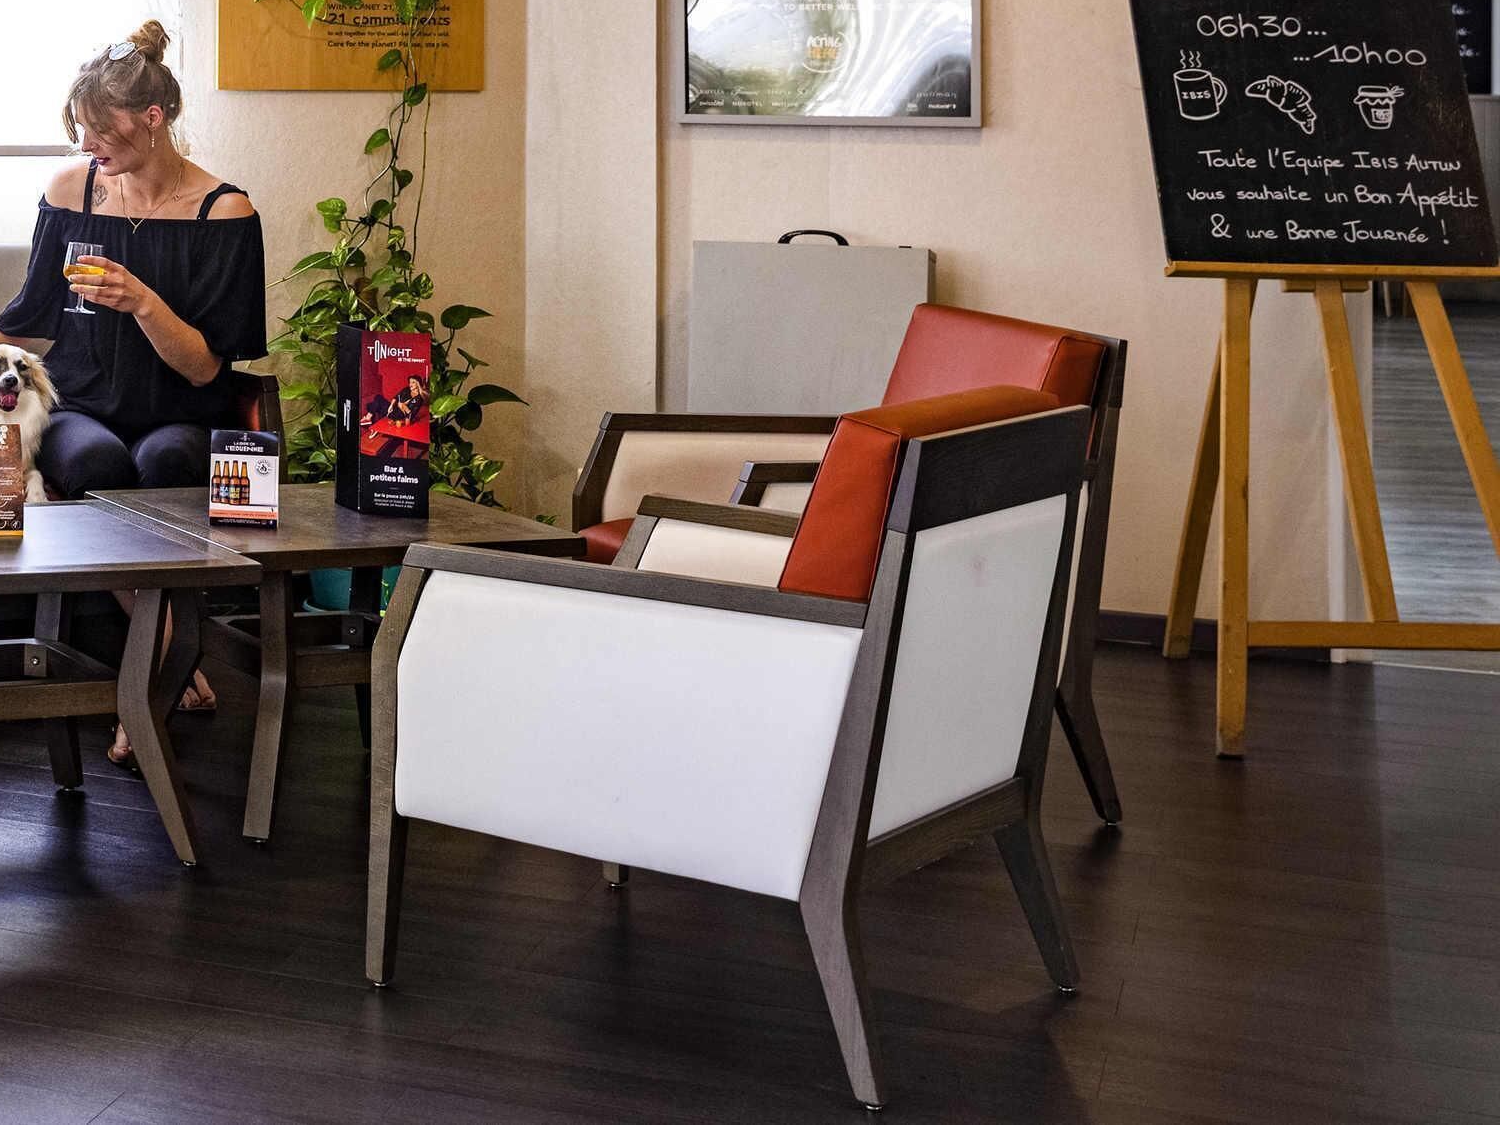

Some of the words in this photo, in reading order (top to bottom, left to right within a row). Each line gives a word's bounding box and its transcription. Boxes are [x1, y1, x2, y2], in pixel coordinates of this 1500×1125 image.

[328, 13, 346, 24] 21
[1181, 91, 1211, 100] IBIS
[1198, 148, 1257, 170] Toute
[1268, 148, 1344, 175] l'Equipe
[1236, 185, 1312, 202] souhaite
[1324, 191, 1350, 204] un
[1353, 184, 1392, 205] Bon
[1396, 183, 1480, 217] Appétit
[1210, 213, 1233, 239] &
[1246, 228, 1278, 241] une
[1285, 218, 1338, 242] Bonne
[1441, 219, 1451, 245] !
[367, 340, 412, 362] TONIGHT
[383, 465, 397, 473] Bar
[370, 473, 396, 482] petites
[397, 475, 419, 484] faims
